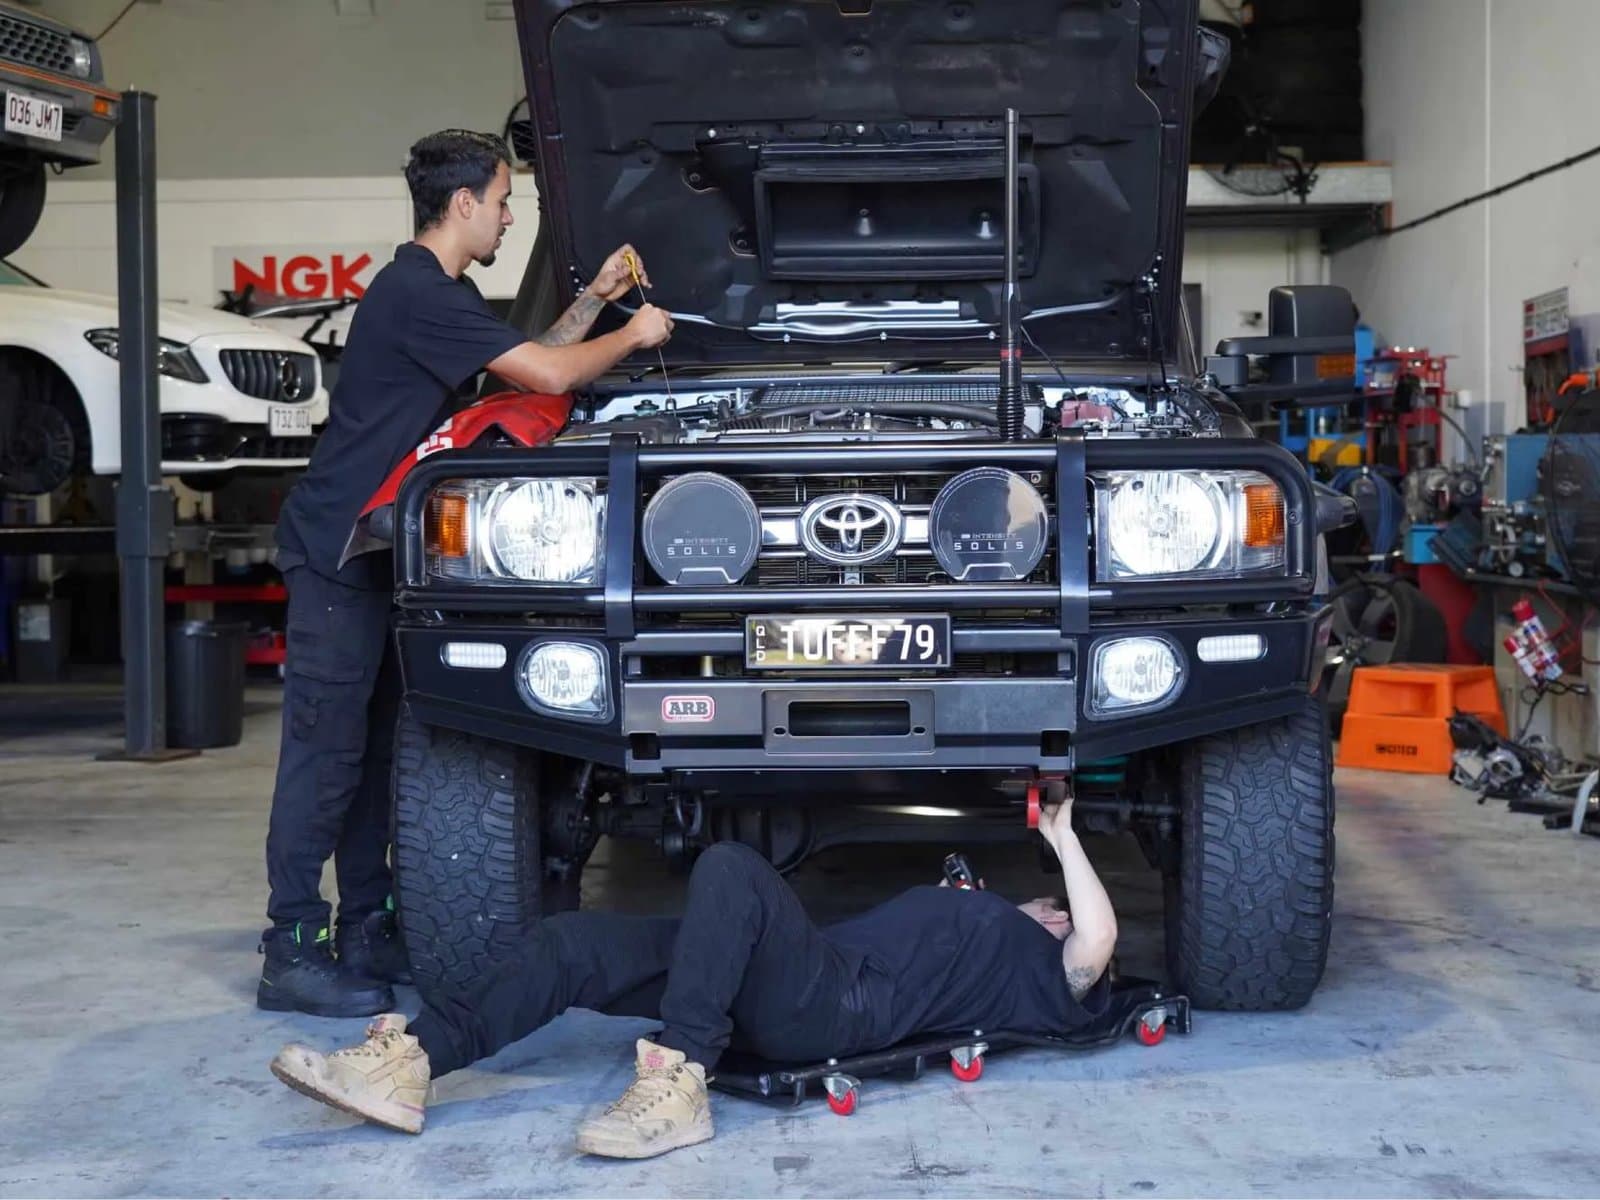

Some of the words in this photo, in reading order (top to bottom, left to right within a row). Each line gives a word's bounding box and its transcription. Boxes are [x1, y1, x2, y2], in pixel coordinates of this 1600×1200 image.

[233, 252, 372, 301] NGK
[667, 546, 737, 556] SOLIS
[953, 541, 1024, 551] SOLIS
[668, 701, 709, 716] ARB
